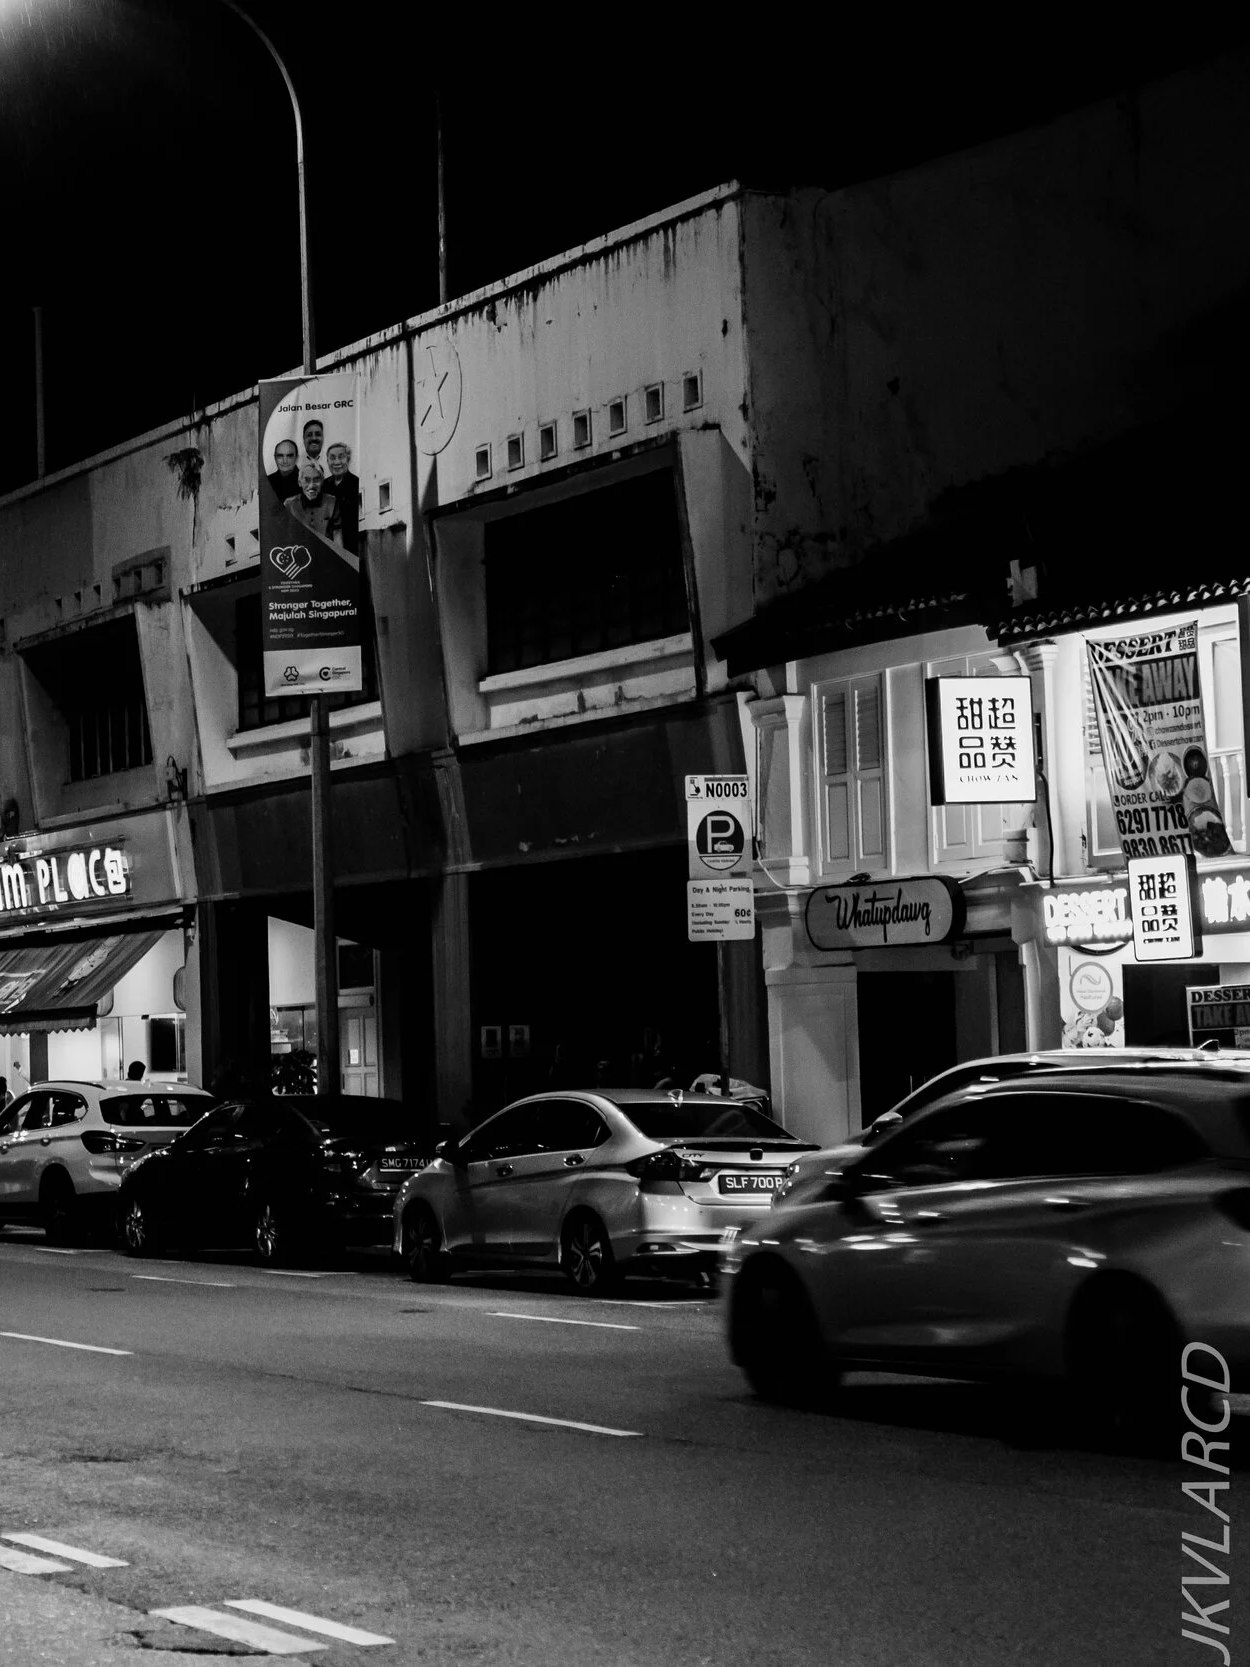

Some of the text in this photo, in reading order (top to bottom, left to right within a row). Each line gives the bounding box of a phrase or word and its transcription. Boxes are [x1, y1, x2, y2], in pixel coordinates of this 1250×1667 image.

[278, 400, 354, 413] Jalan Besar GRC
[268, 598, 352, 611] Stronger Together,
[269, 607, 357, 621] Majulah Singapura!
[1090, 630, 1177, 663] DESSERT
[1141, 655, 1195, 703] AWAY
[1143, 710, 1164, 724] 2pm
[1172, 704, 1200, 720] 10pm
[705, 782, 748, 798] N0003
[1120, 791, 1170, 806] ORDER CALL
[1116, 803, 1189, 835] 6297 7718
[692, 887, 704, 895] Day
[712, 886, 728, 894] Night
[734, 908, 752, 918] 60¢
[824, 887, 932, 944] Whatupdawg
[1194, 1005, 1232, 1028] TAKE
